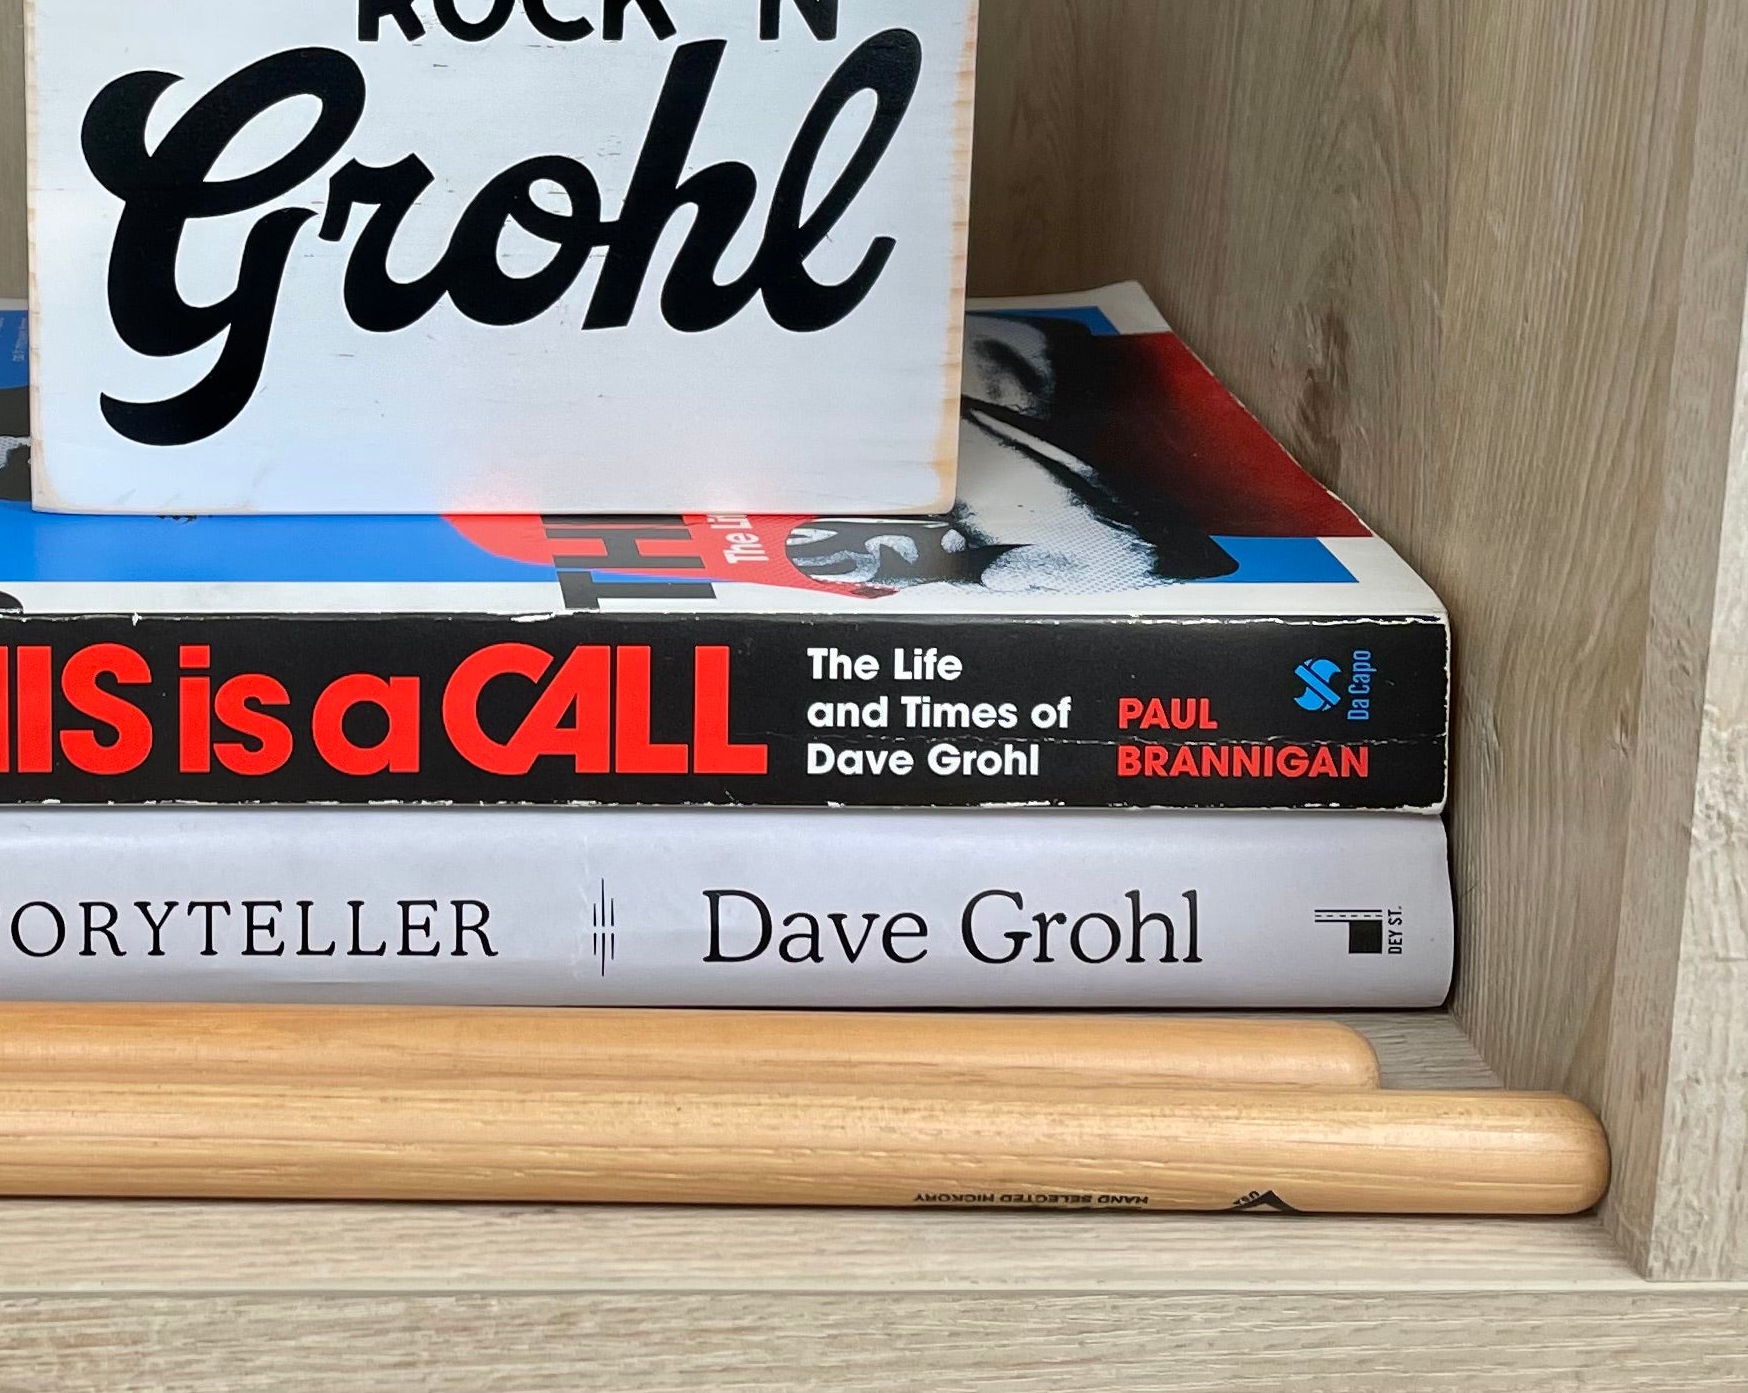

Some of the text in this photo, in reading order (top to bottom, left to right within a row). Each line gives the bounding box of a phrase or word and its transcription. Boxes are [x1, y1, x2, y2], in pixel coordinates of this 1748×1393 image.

[81, 28, 923, 446] Grohl
[723, 532, 770, 564] The
[807, 647, 963, 681] The Life
[1347, 650, 1378, 720] Da Capo
[179, 643, 293, 775] is
[312, 673, 420, 776] a
[442, 642, 768, 775] CALL
[806, 695, 1072, 730] and Times of
[1118, 698, 1218, 731] PAUL
[806, 743, 1040, 777] Dave Grohl
[1117, 744, 1369, 779] BRANNIGAN
[702, 889, 929, 965] Dave
[961, 888, 1204, 965] Grohl
[1388, 905, 1403, 955] DEY ST.
[914, 1193, 1148, 1205] HAND SELECTED HICKORY
